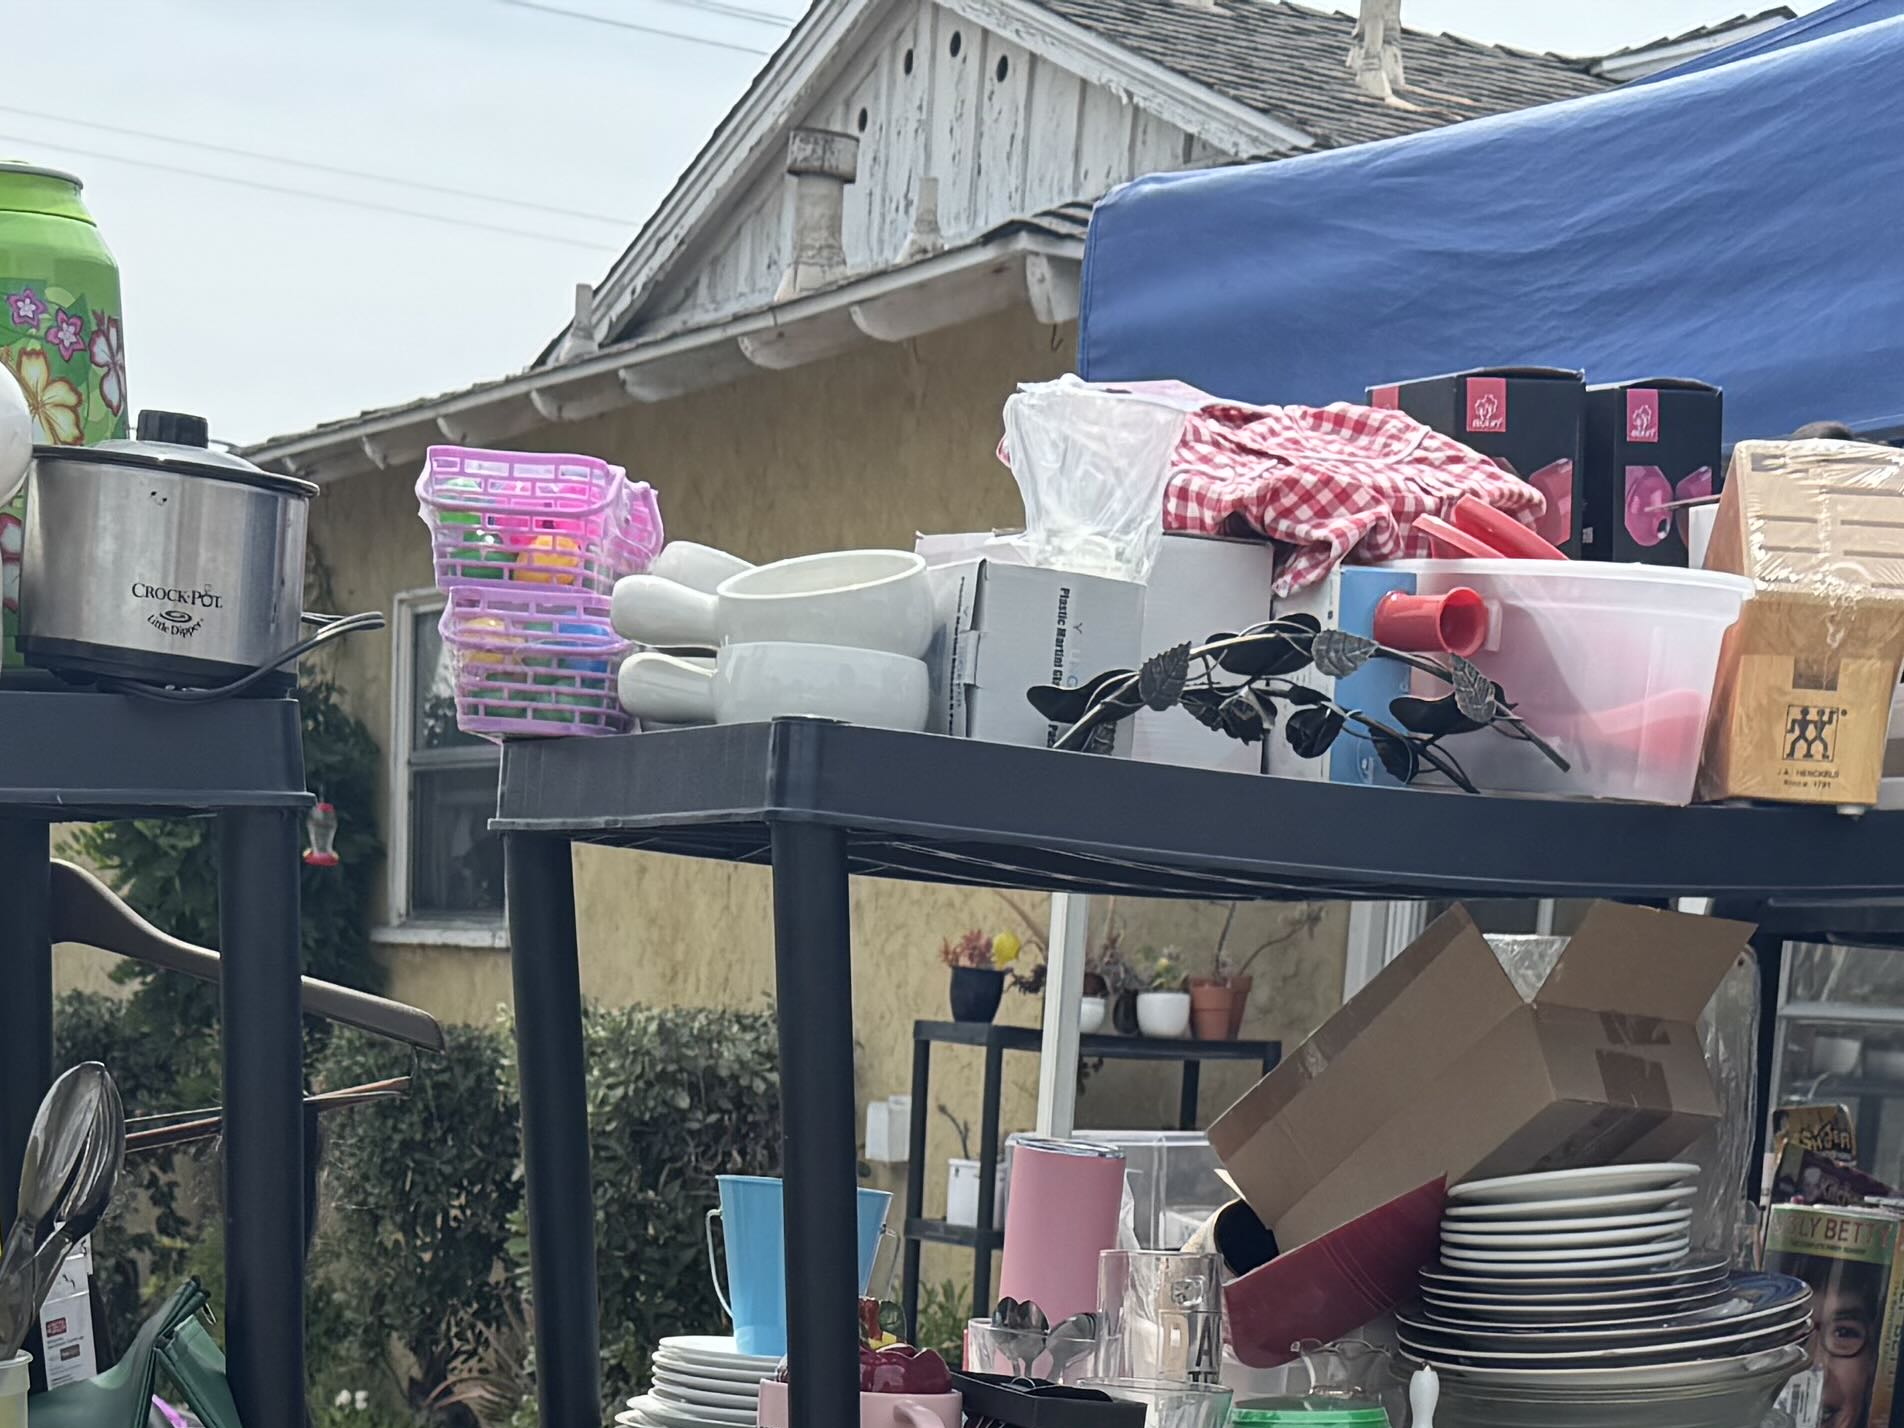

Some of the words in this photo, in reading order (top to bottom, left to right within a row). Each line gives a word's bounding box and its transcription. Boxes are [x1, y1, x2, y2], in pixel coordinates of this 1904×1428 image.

[1057, 588, 1071, 625] Plastic
[147, 614, 170, 633] Little
[171, 620, 202, 639] Dipper
[1054, 627, 1067, 667] Martini
